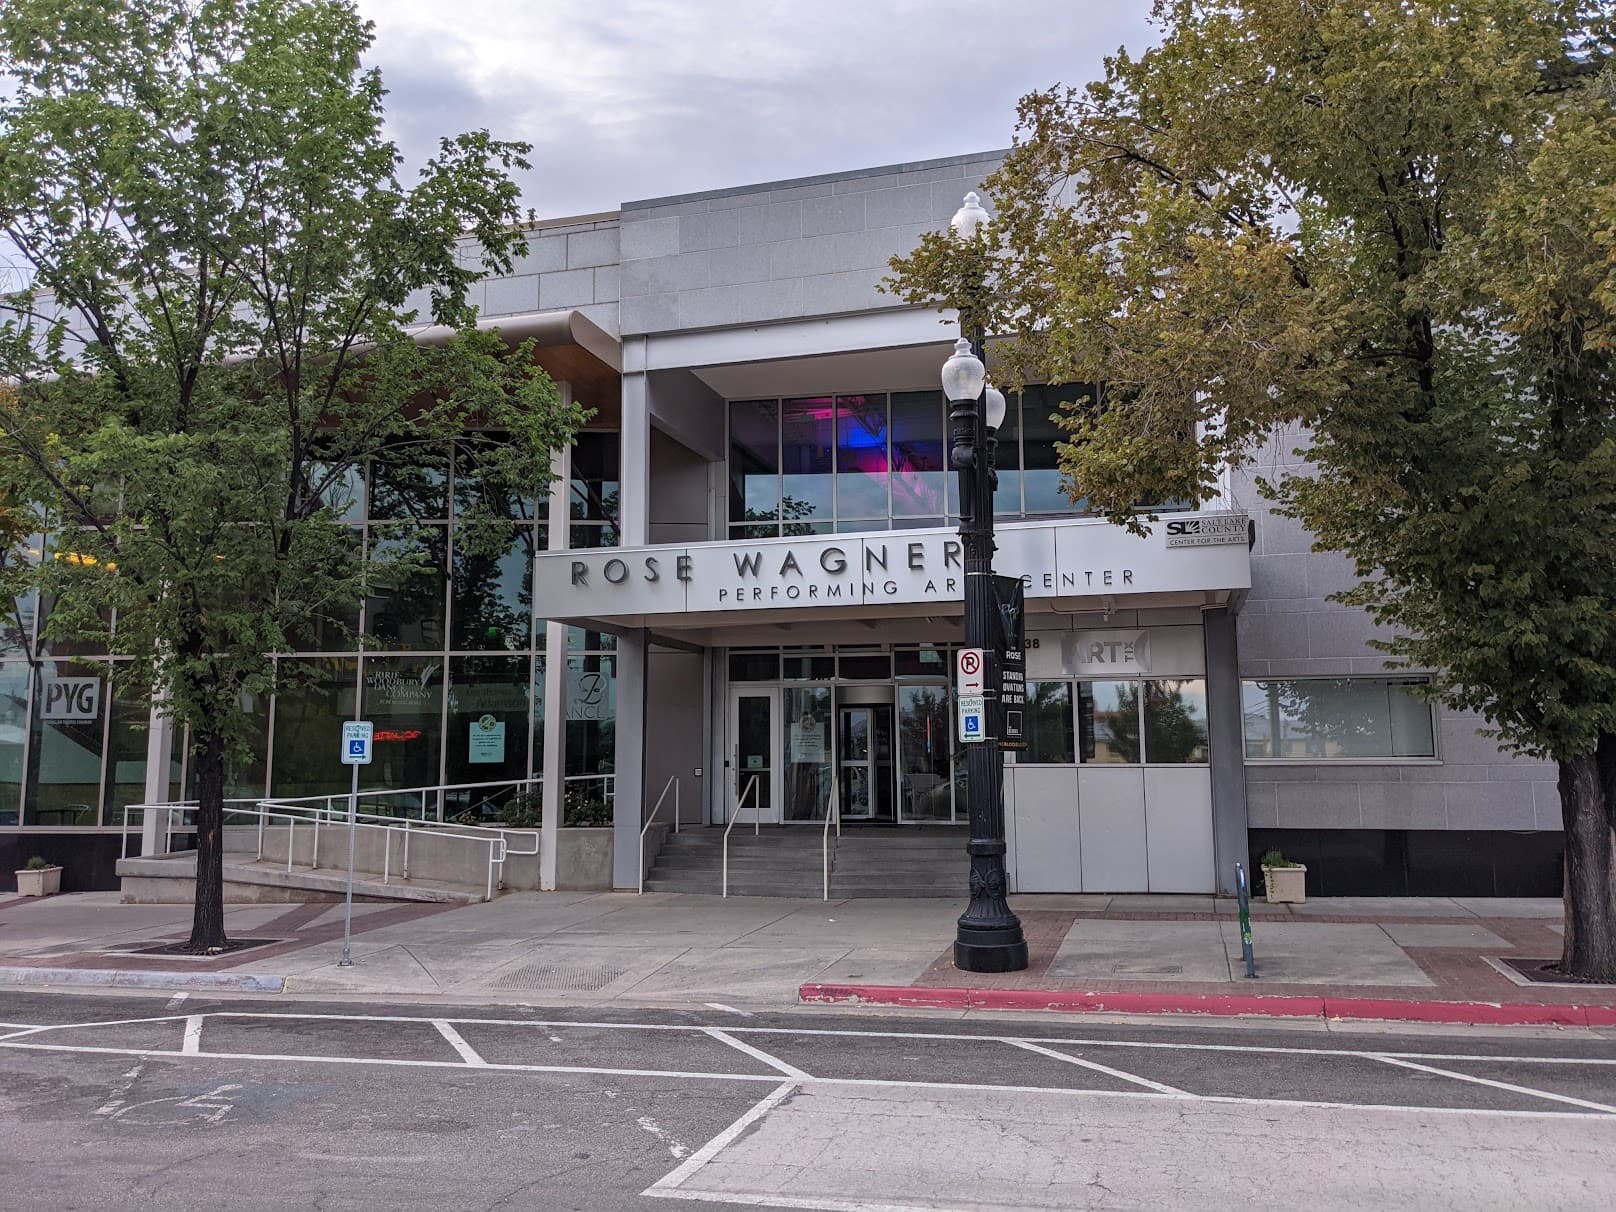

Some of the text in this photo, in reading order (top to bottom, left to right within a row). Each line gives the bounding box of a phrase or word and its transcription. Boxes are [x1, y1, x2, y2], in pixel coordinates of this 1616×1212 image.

[1201, 525, 1246, 534] COUNTY
[1169, 538, 1195, 546] CENTER
[571, 541, 962, 586] ROSE WAGNER
[719, 569, 1134, 602] PERFORMING AR CENTER
[1005, 650, 1021, 660] ROSE
[45, 683, 94, 714] PYG
[1001, 695, 1012, 703] ARE
